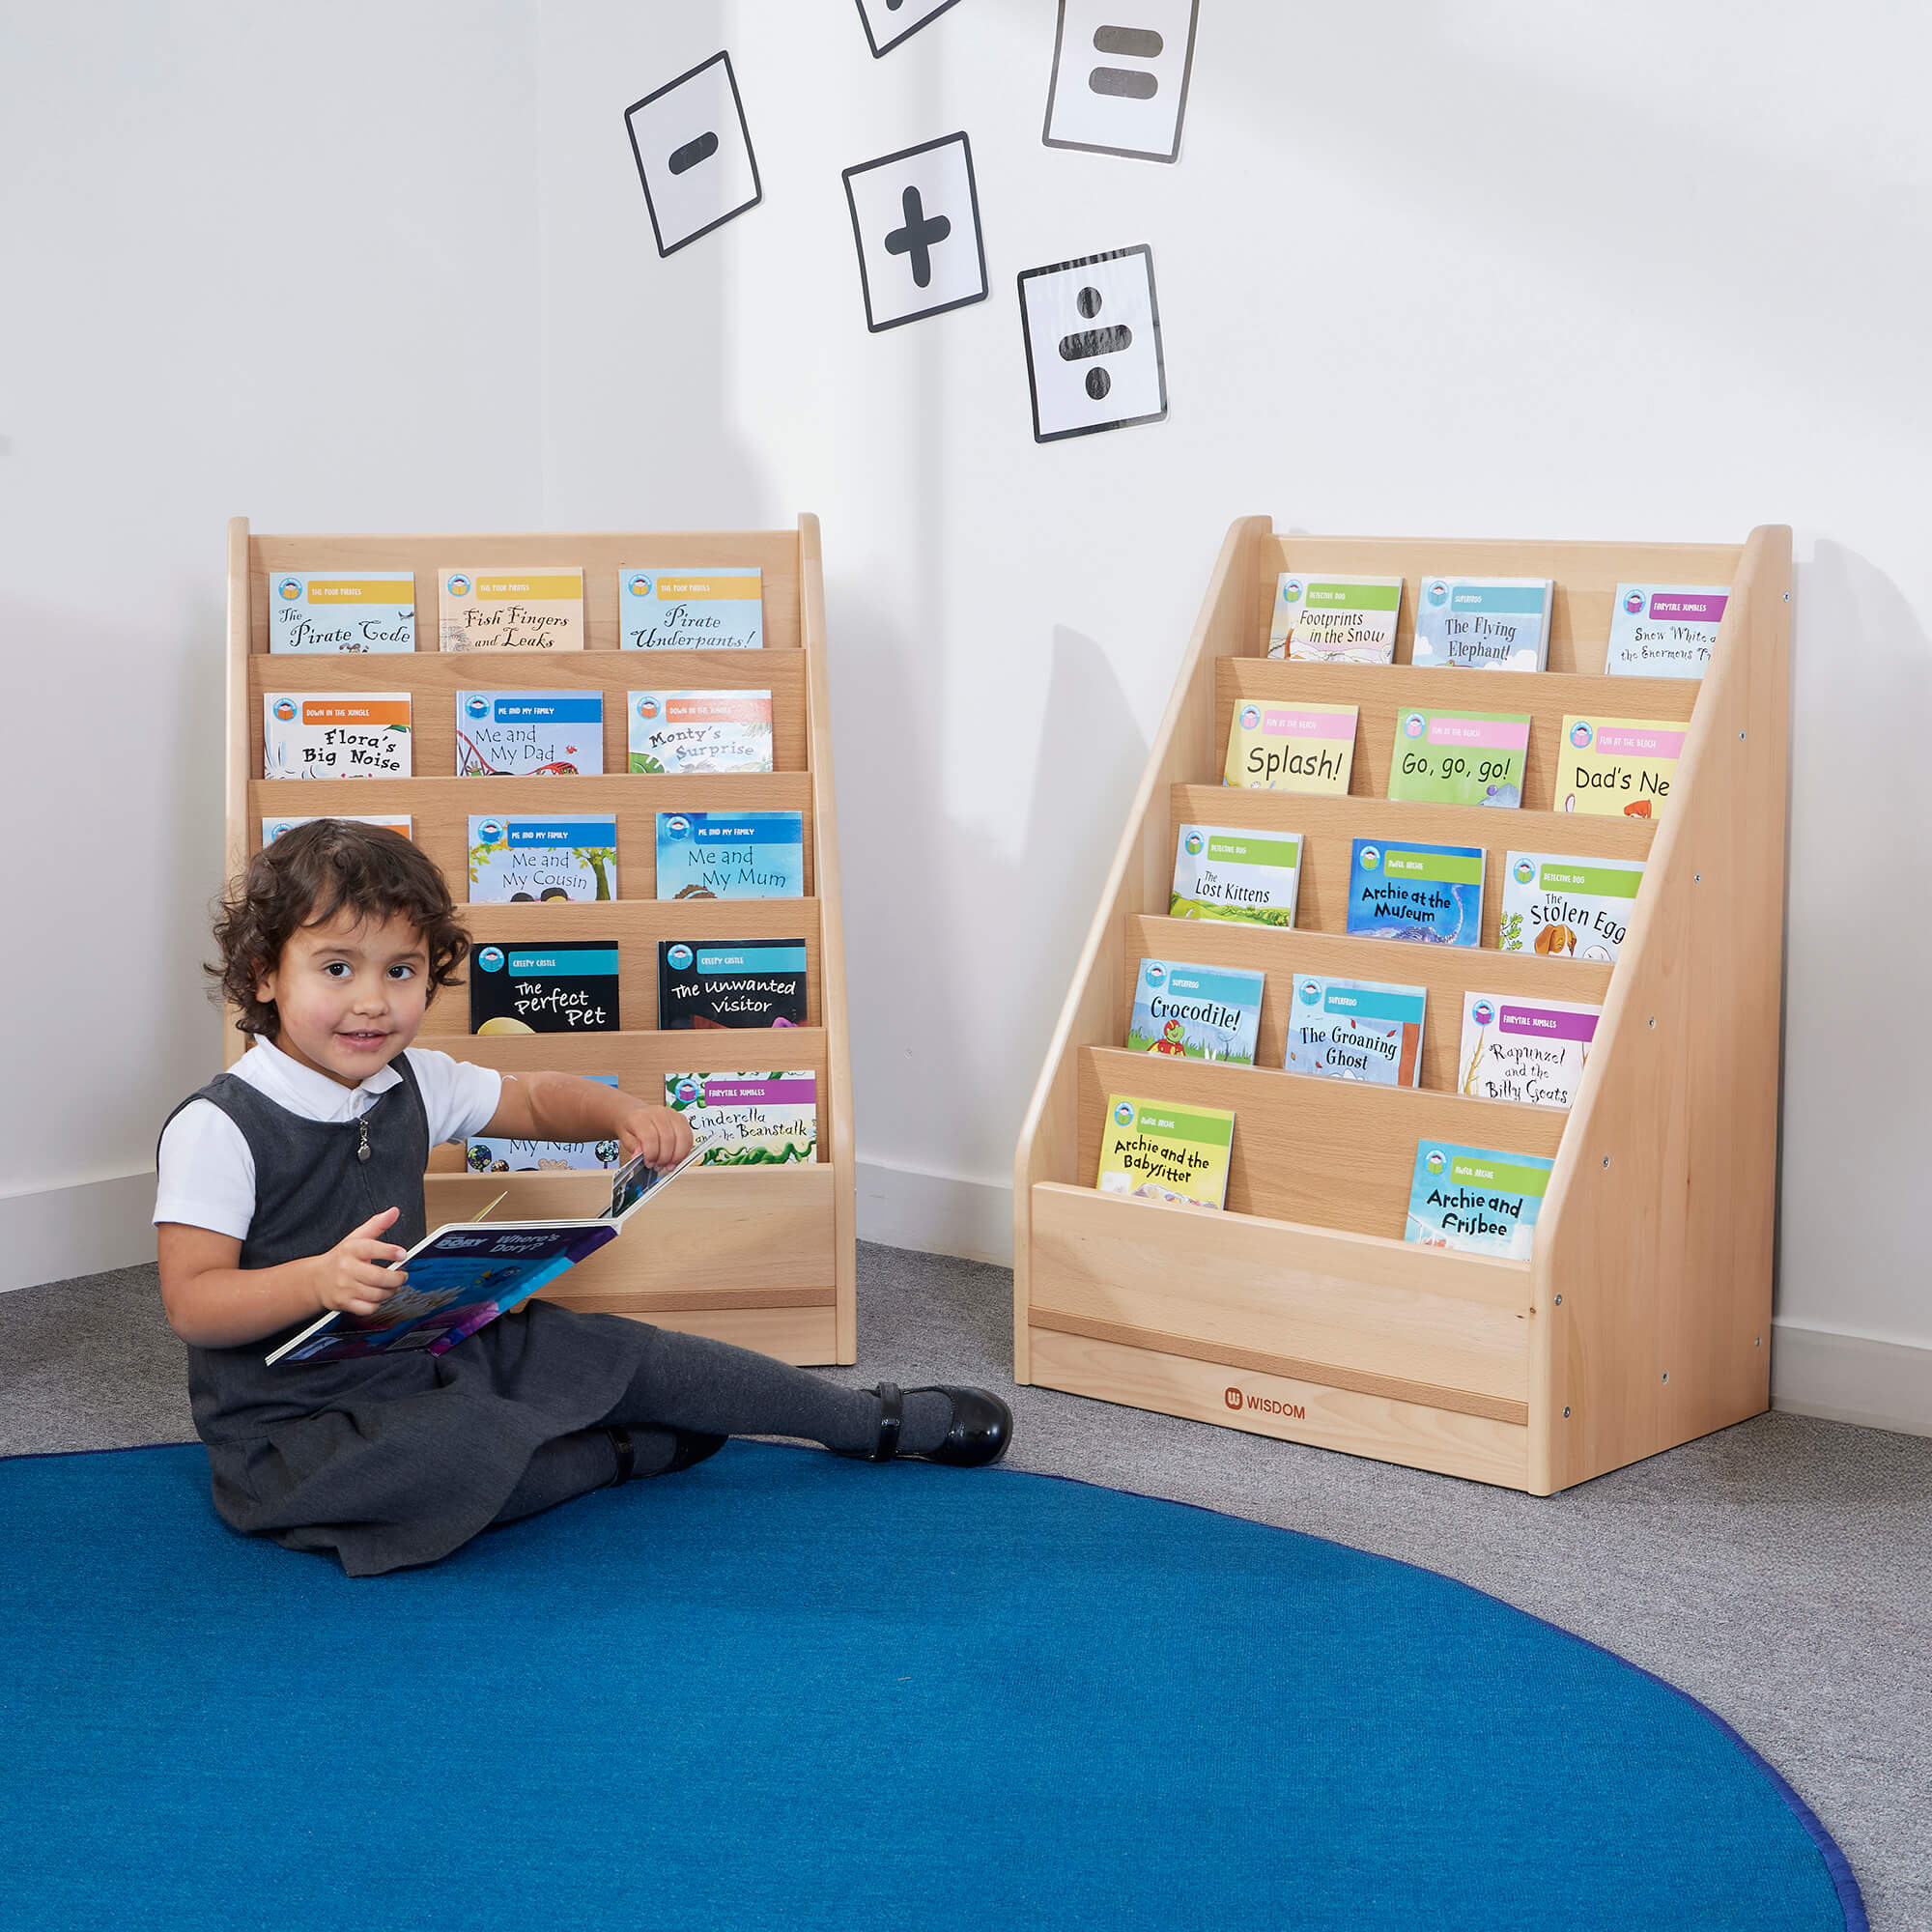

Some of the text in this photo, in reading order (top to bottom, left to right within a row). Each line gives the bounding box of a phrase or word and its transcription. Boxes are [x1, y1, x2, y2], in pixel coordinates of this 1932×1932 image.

[278, 608, 302, 622] The
[664, 604, 721, 628] Pirate
[1654, 602, 1707, 612] FAIRYTALE JUMBLES
[464, 606, 569, 631] Fish Fingers
[1299, 611, 1363, 629] Footprints
[1445, 616, 1517, 642] The Flying
[290, 619, 411, 647] Pirate Code
[475, 627, 554, 648] and Leaks
[630, 628, 756, 649] Underpants!
[1309, 629, 1385, 643] in the Snow
[1634, 627, 1665, 642] Snow
[1669, 626, 1707, 643] White
[1449, 640, 1511, 661] Elephant!
[1621, 651, 1638, 662] the
[1641, 645, 1693, 661] Enormous
[509, 706, 521, 715] AND
[533, 706, 555, 715] FAMILY
[325, 728, 396, 753] Flora's
[475, 724, 536, 745] Me and
[648, 726, 722, 749] Monty's
[1623, 737, 1634, 747] THE
[1636, 739, 1657, 749] BEACH
[302, 748, 400, 772] Big Noise
[491, 744, 554, 765] My Dad
[675, 742, 754, 761] Surprise
[1247, 745, 1344, 781] Splash!
[1402, 753, 1511, 781] Go, go, go!
[1576, 766, 1670, 796] Dad's Ne
[512, 851, 569, 868] Me and
[689, 845, 753, 866] Me and
[502, 870, 587, 890] My Cousin
[703, 868, 786, 891] My Mum
[1205, 870, 1218, 883] The
[1543, 872, 1585, 885] DETECTIVE DOG
[1195, 878, 1270, 903] Lost Kittens
[1361, 882, 1451, 909] Archie at the
[1545, 893, 1562, 905] The
[1374, 901, 1435, 923] Museum
[1530, 902, 1627, 945] Stolen Egg
[701, 956, 744, 965] CREEPY CASTLE
[515, 981, 542, 996] The
[671, 984, 700, 999] The
[514, 987, 589, 1015] Perfect
[565, 1007, 607, 1026] Pet
[1151, 996, 1241, 1032] Crocodile!
[1503, 1014, 1557, 1029] FAIRYTALE JUMBLES
[1300, 1025, 1398, 1061] The Groaning
[1325, 1047, 1369, 1070] Ghost
[1489, 1043, 1566, 1066] Rapunzel
[1505, 1064, 1549, 1079] and the
[708, 1089, 765, 1097] FAIRYTALE JUMBLES
[1486, 1080, 1568, 1104] Billy Goats
[689, 1107, 765, 1130] Cinderella
[720, 1128, 735, 1141] he
[736, 1119, 808, 1139] Beanstalk
[510, 1139, 538, 1156] My
[1114, 1134, 1209, 1169] Archie and the
[1123, 1153, 1191, 1183] Babysitter
[1426, 1188, 1523, 1218] Archie and
[1441, 1212, 1508, 1236] Frisbee
[489, 1242, 545, 1253] Dory?
[496, 1234, 561, 1244] Where's
[1246, 1395, 1306, 1420] WISDOM
